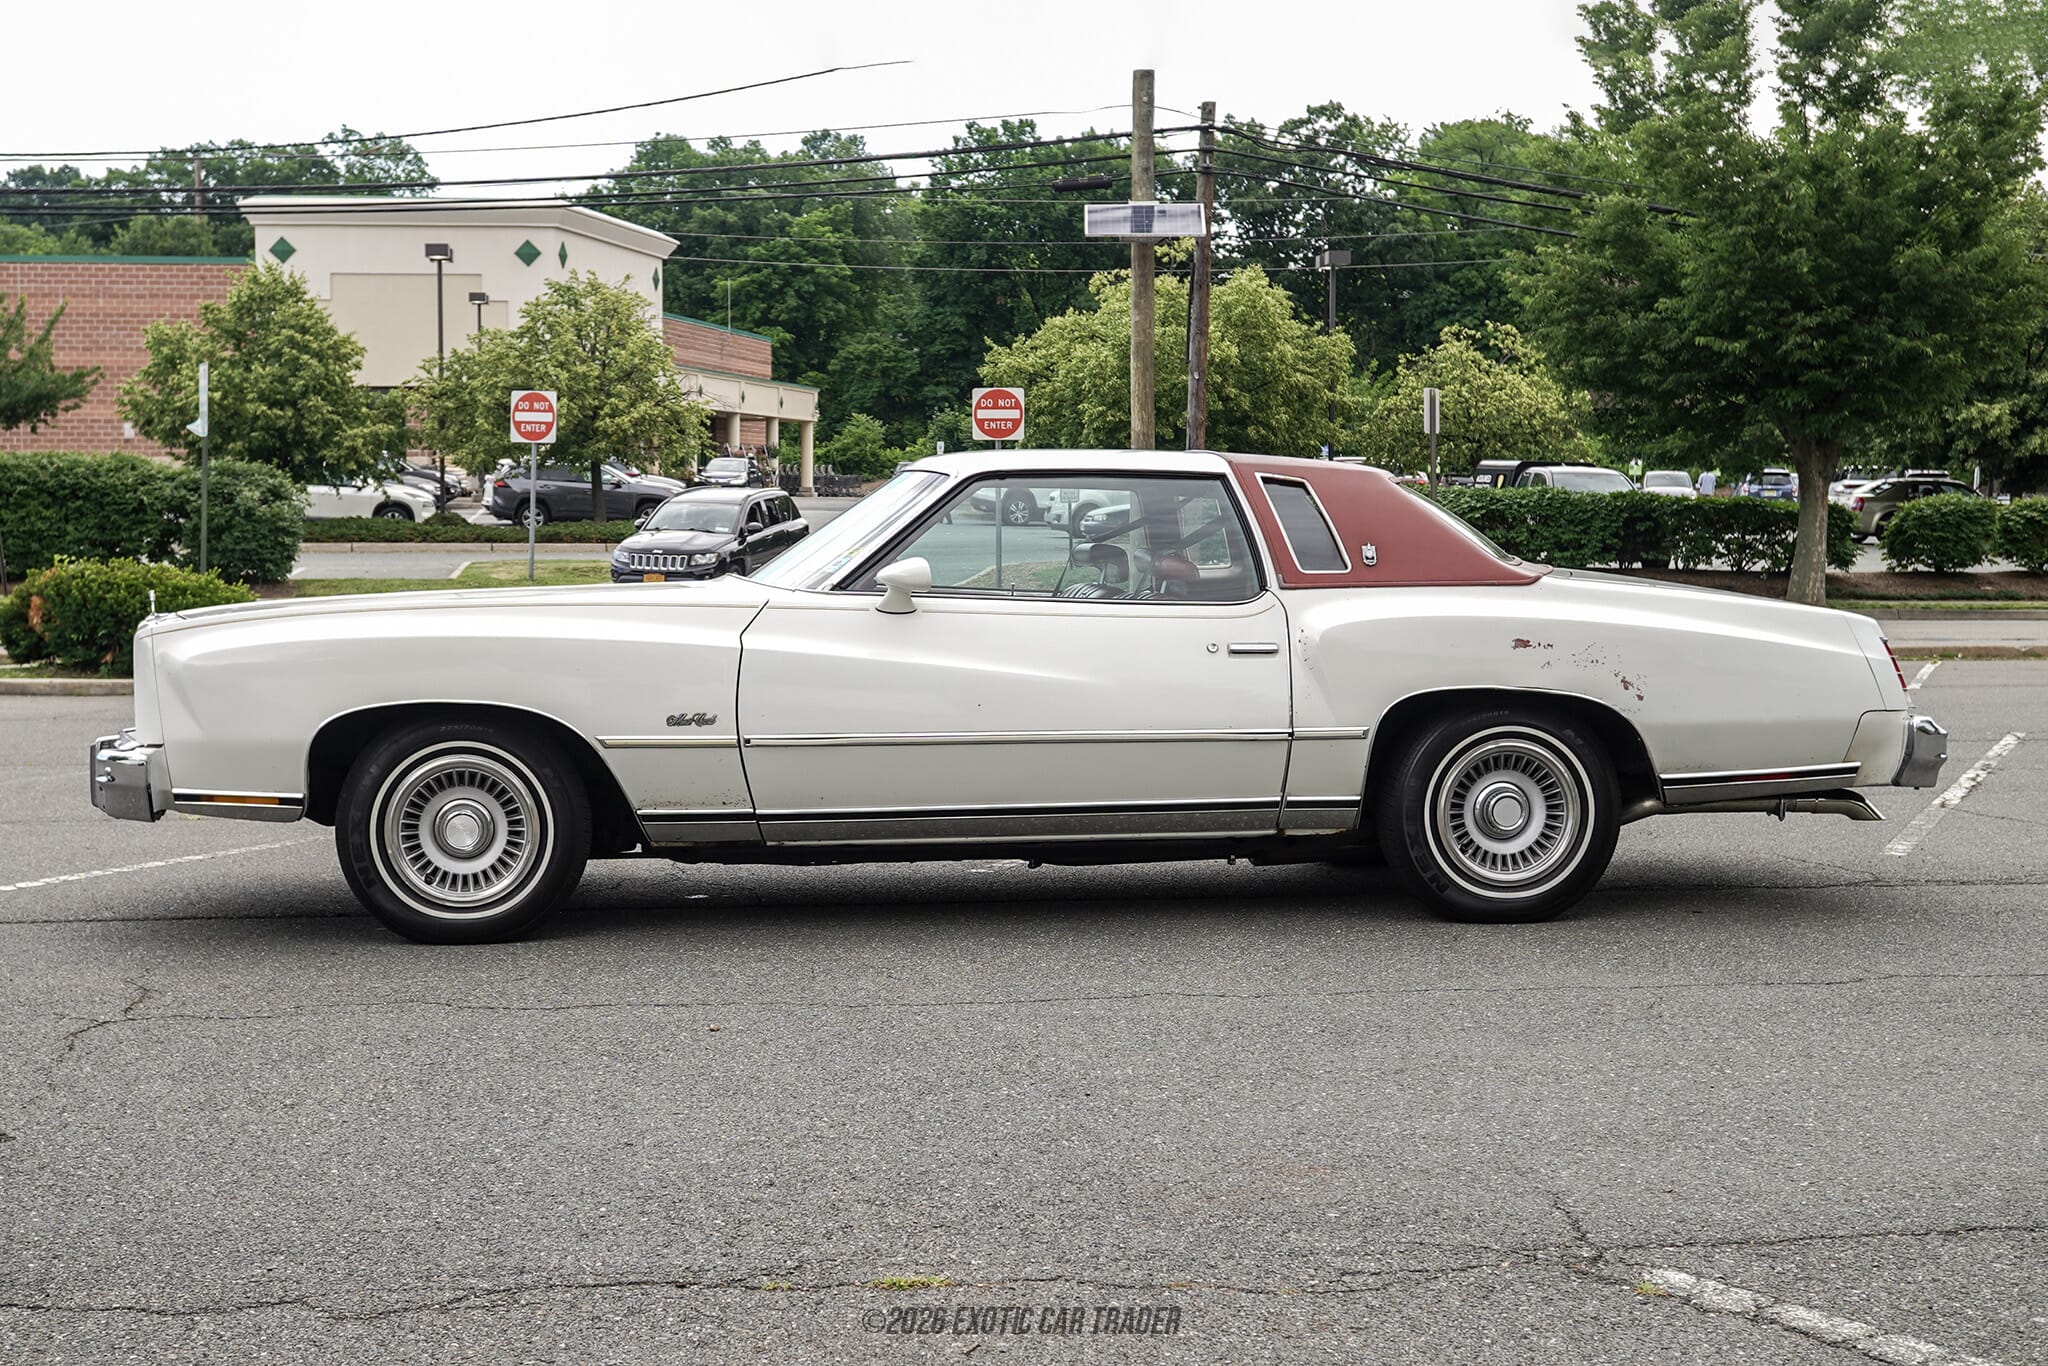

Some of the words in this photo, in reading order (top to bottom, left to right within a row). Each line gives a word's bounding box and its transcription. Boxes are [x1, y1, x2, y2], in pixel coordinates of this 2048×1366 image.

[518, 401, 530, 410] DO
[533, 401, 550, 410] NOT
[980, 398, 993, 407] DO
[998, 398, 1016, 407] NOT
[520, 423, 546, 432] ENTER
[984, 421, 1013, 430] ENTER
